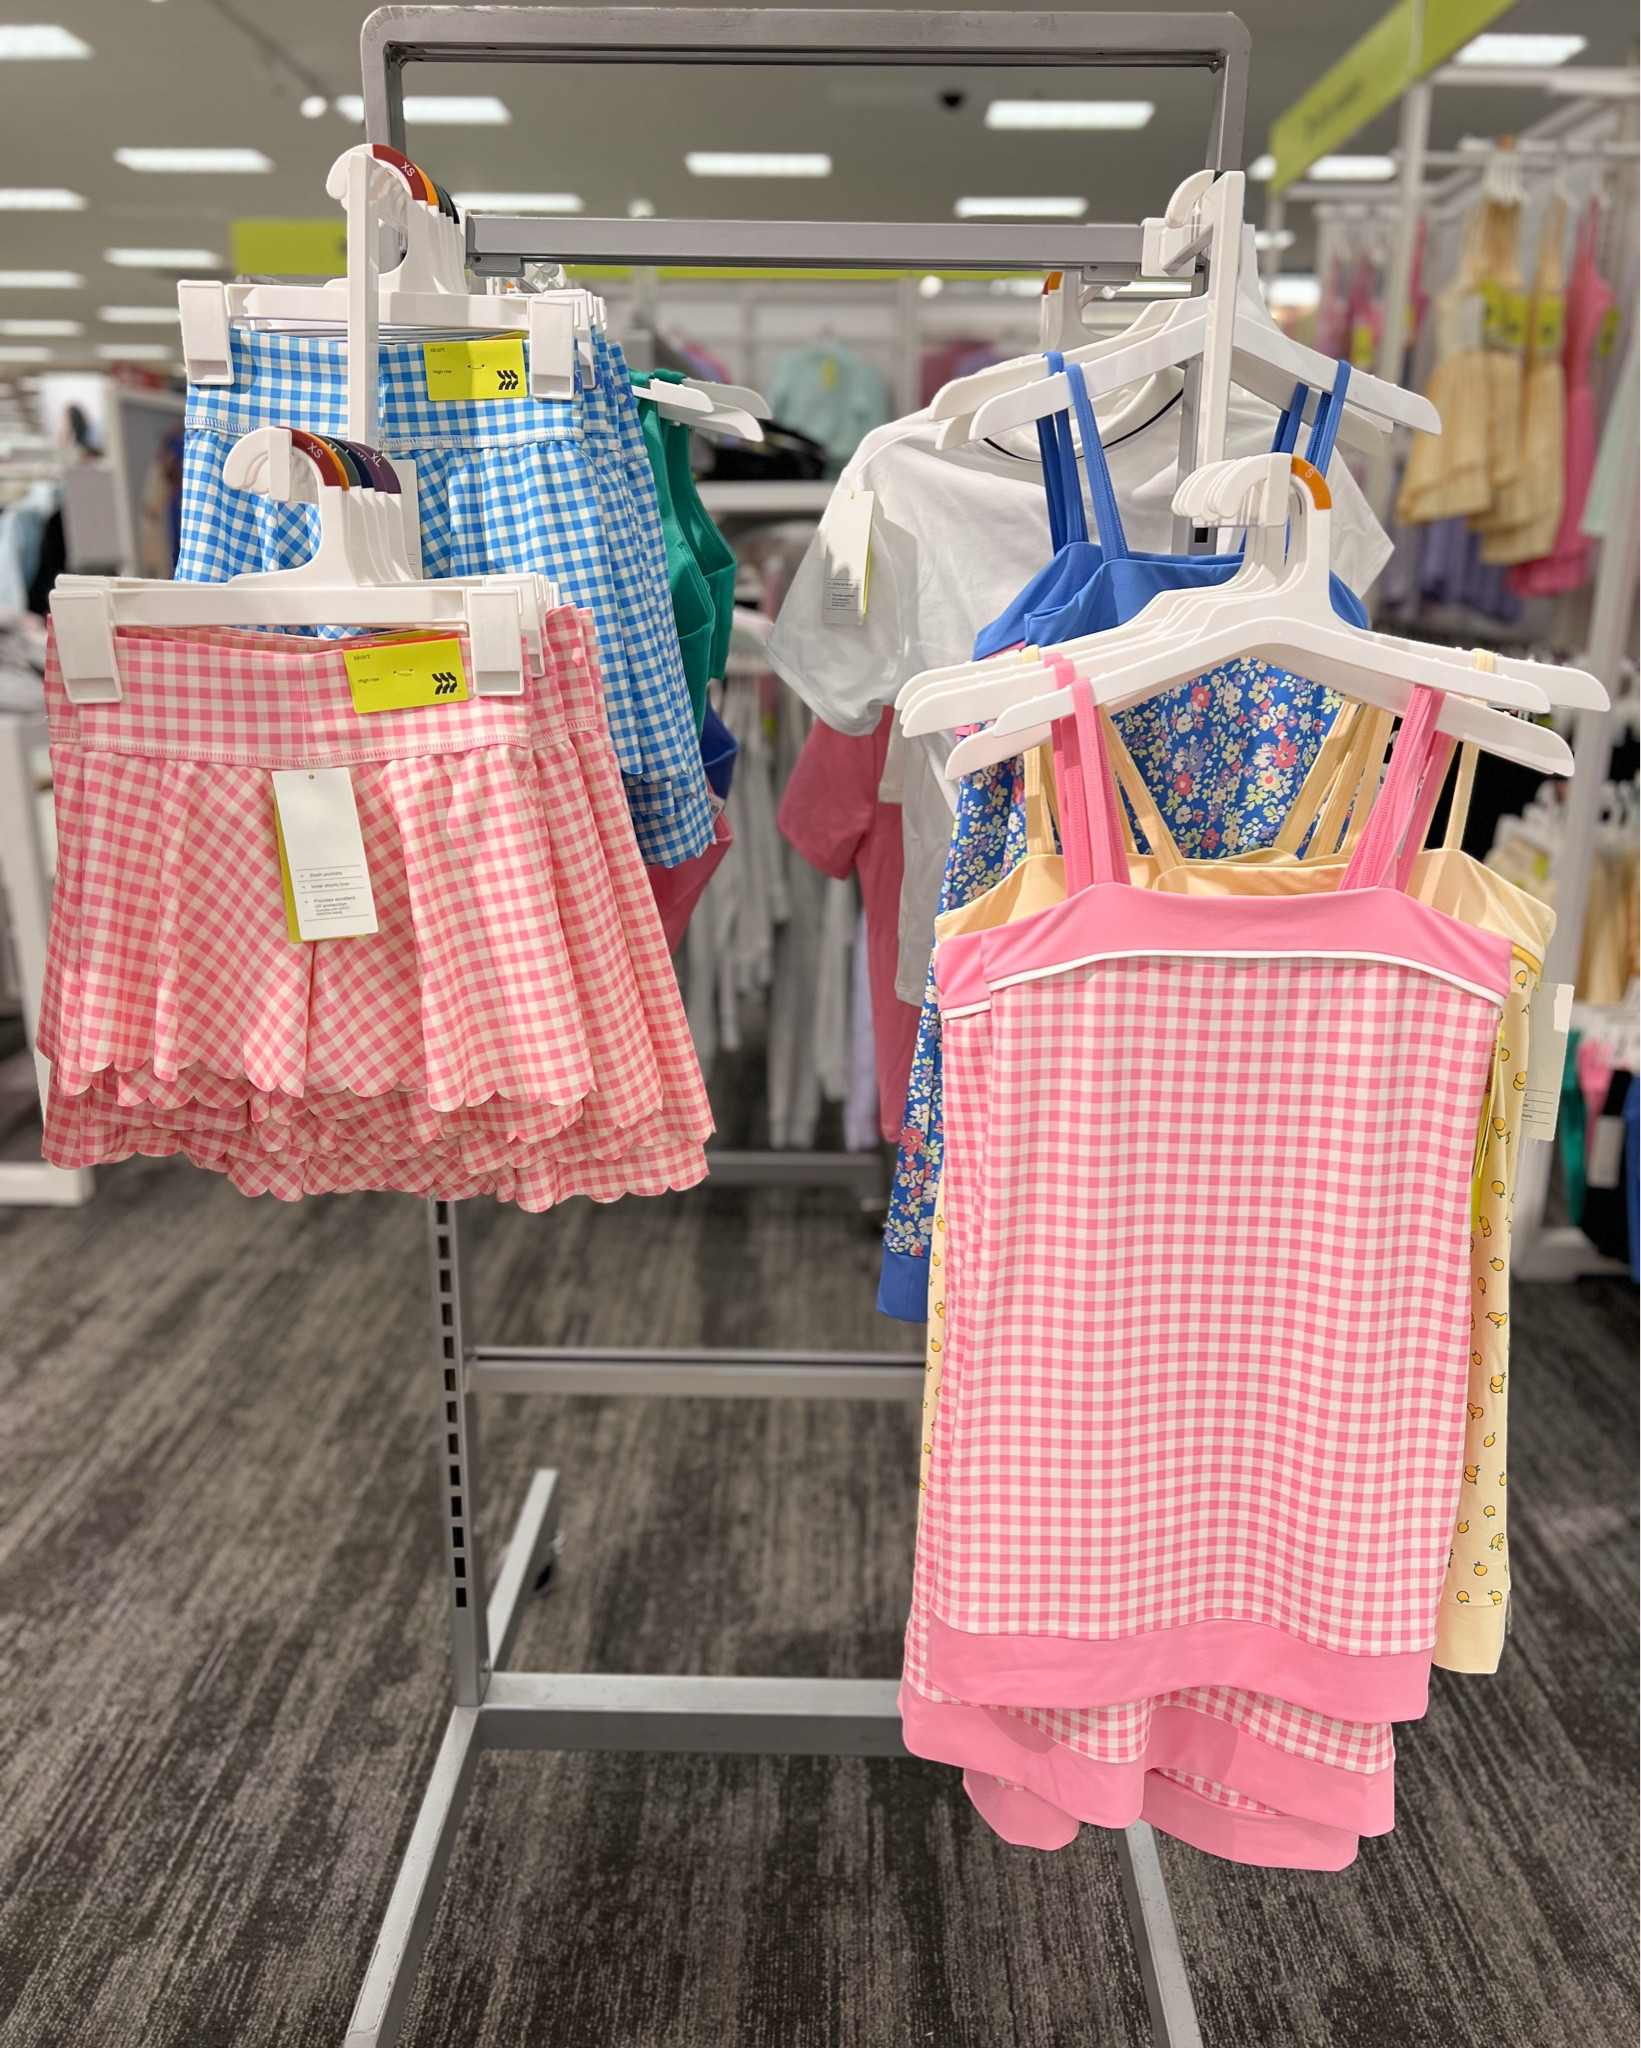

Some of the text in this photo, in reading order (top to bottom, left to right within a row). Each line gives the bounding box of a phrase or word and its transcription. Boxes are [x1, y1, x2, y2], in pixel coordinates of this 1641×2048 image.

[400, 161, 416, 177] XS
[307, 442, 323, 459] XS
[371, 452, 382, 468] XL
[1304, 467, 1315, 479] S
